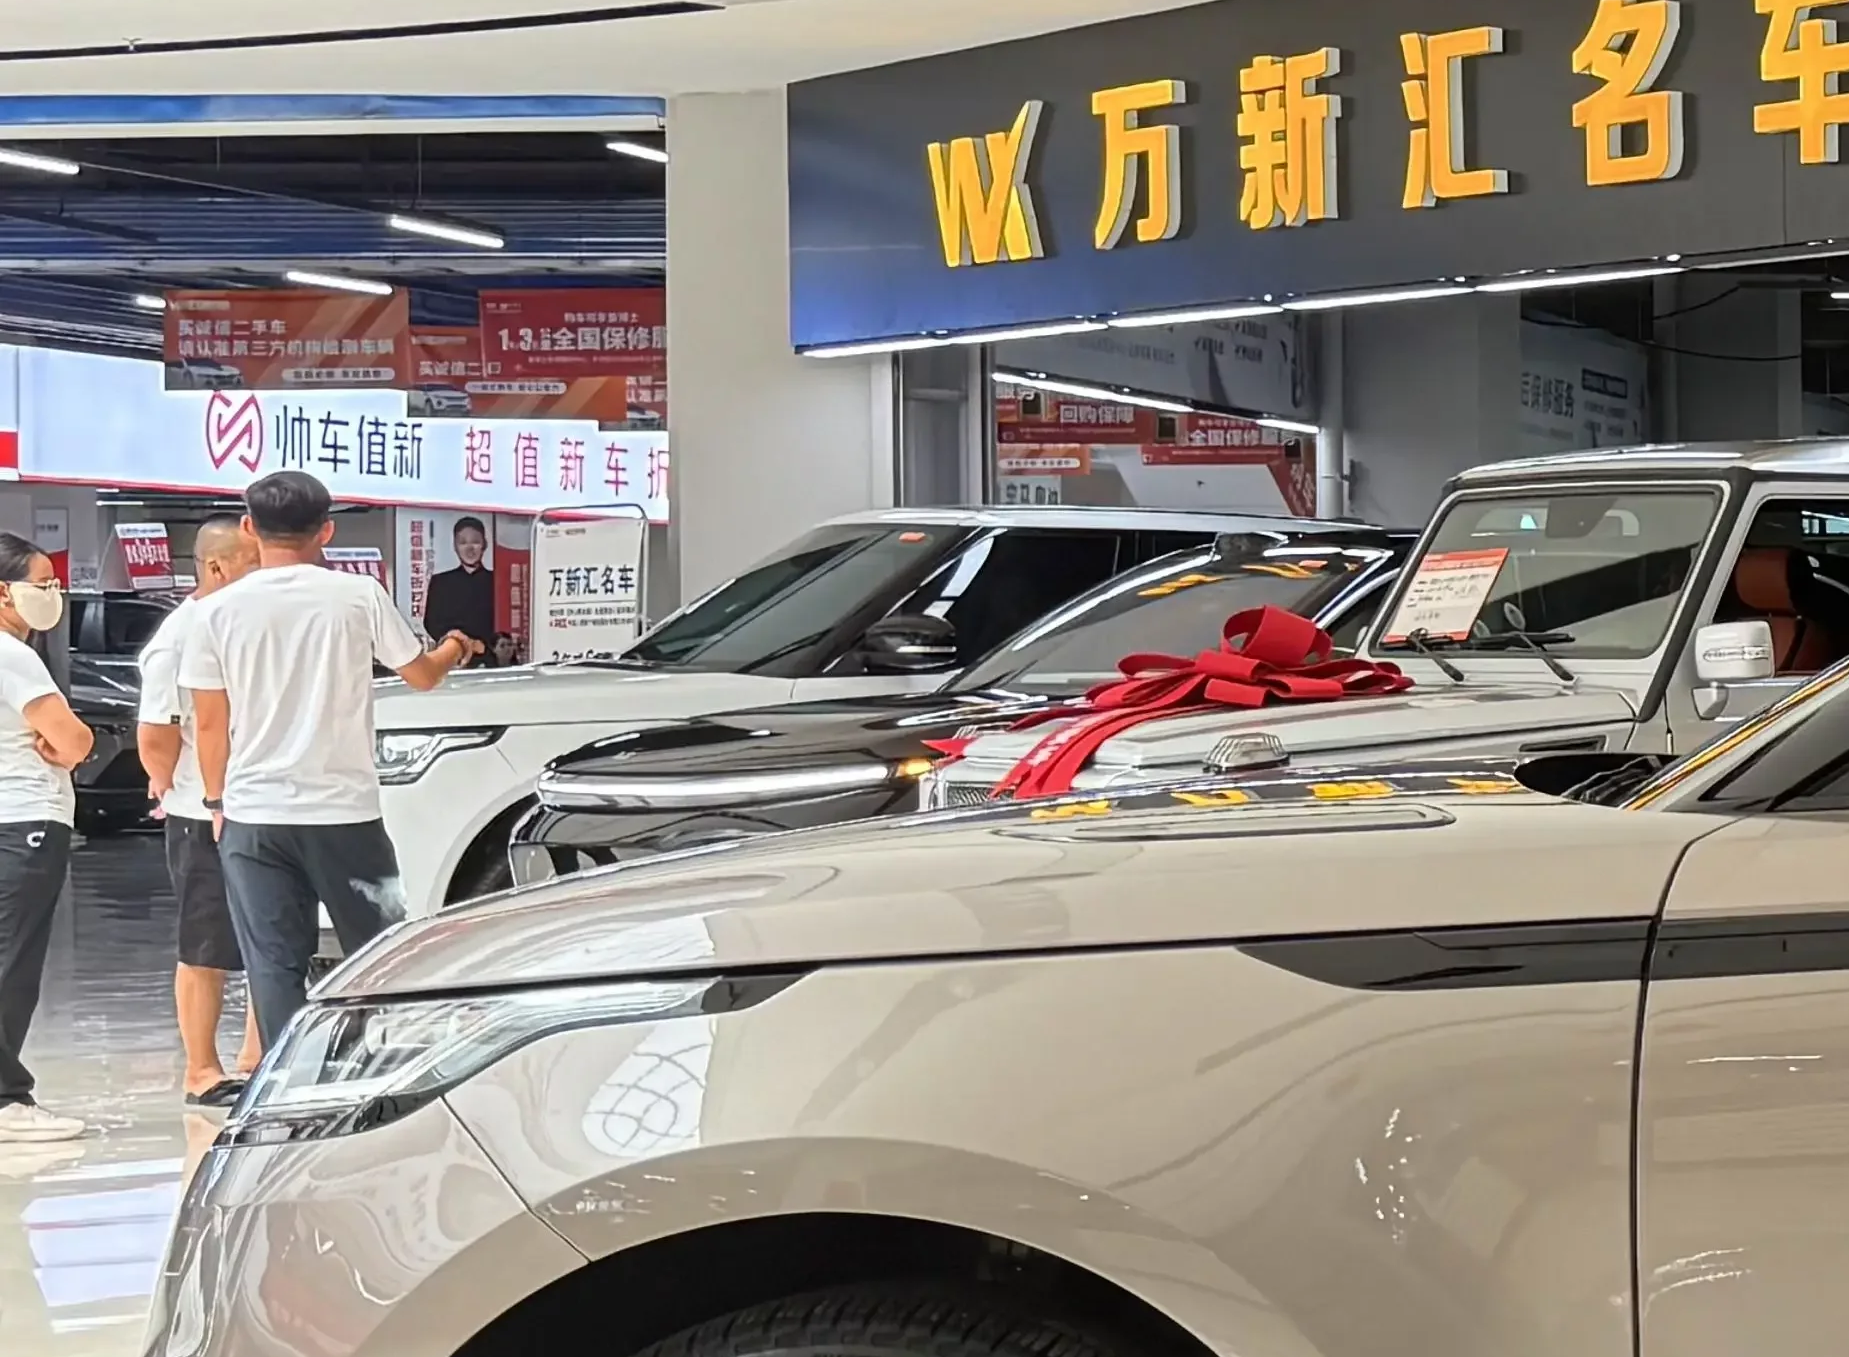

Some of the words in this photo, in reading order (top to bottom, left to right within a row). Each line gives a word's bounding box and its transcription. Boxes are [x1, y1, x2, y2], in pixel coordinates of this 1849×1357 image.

[1059, 404, 1135, 425] 回购保障
[548, 563, 636, 598] 万新汇名车
